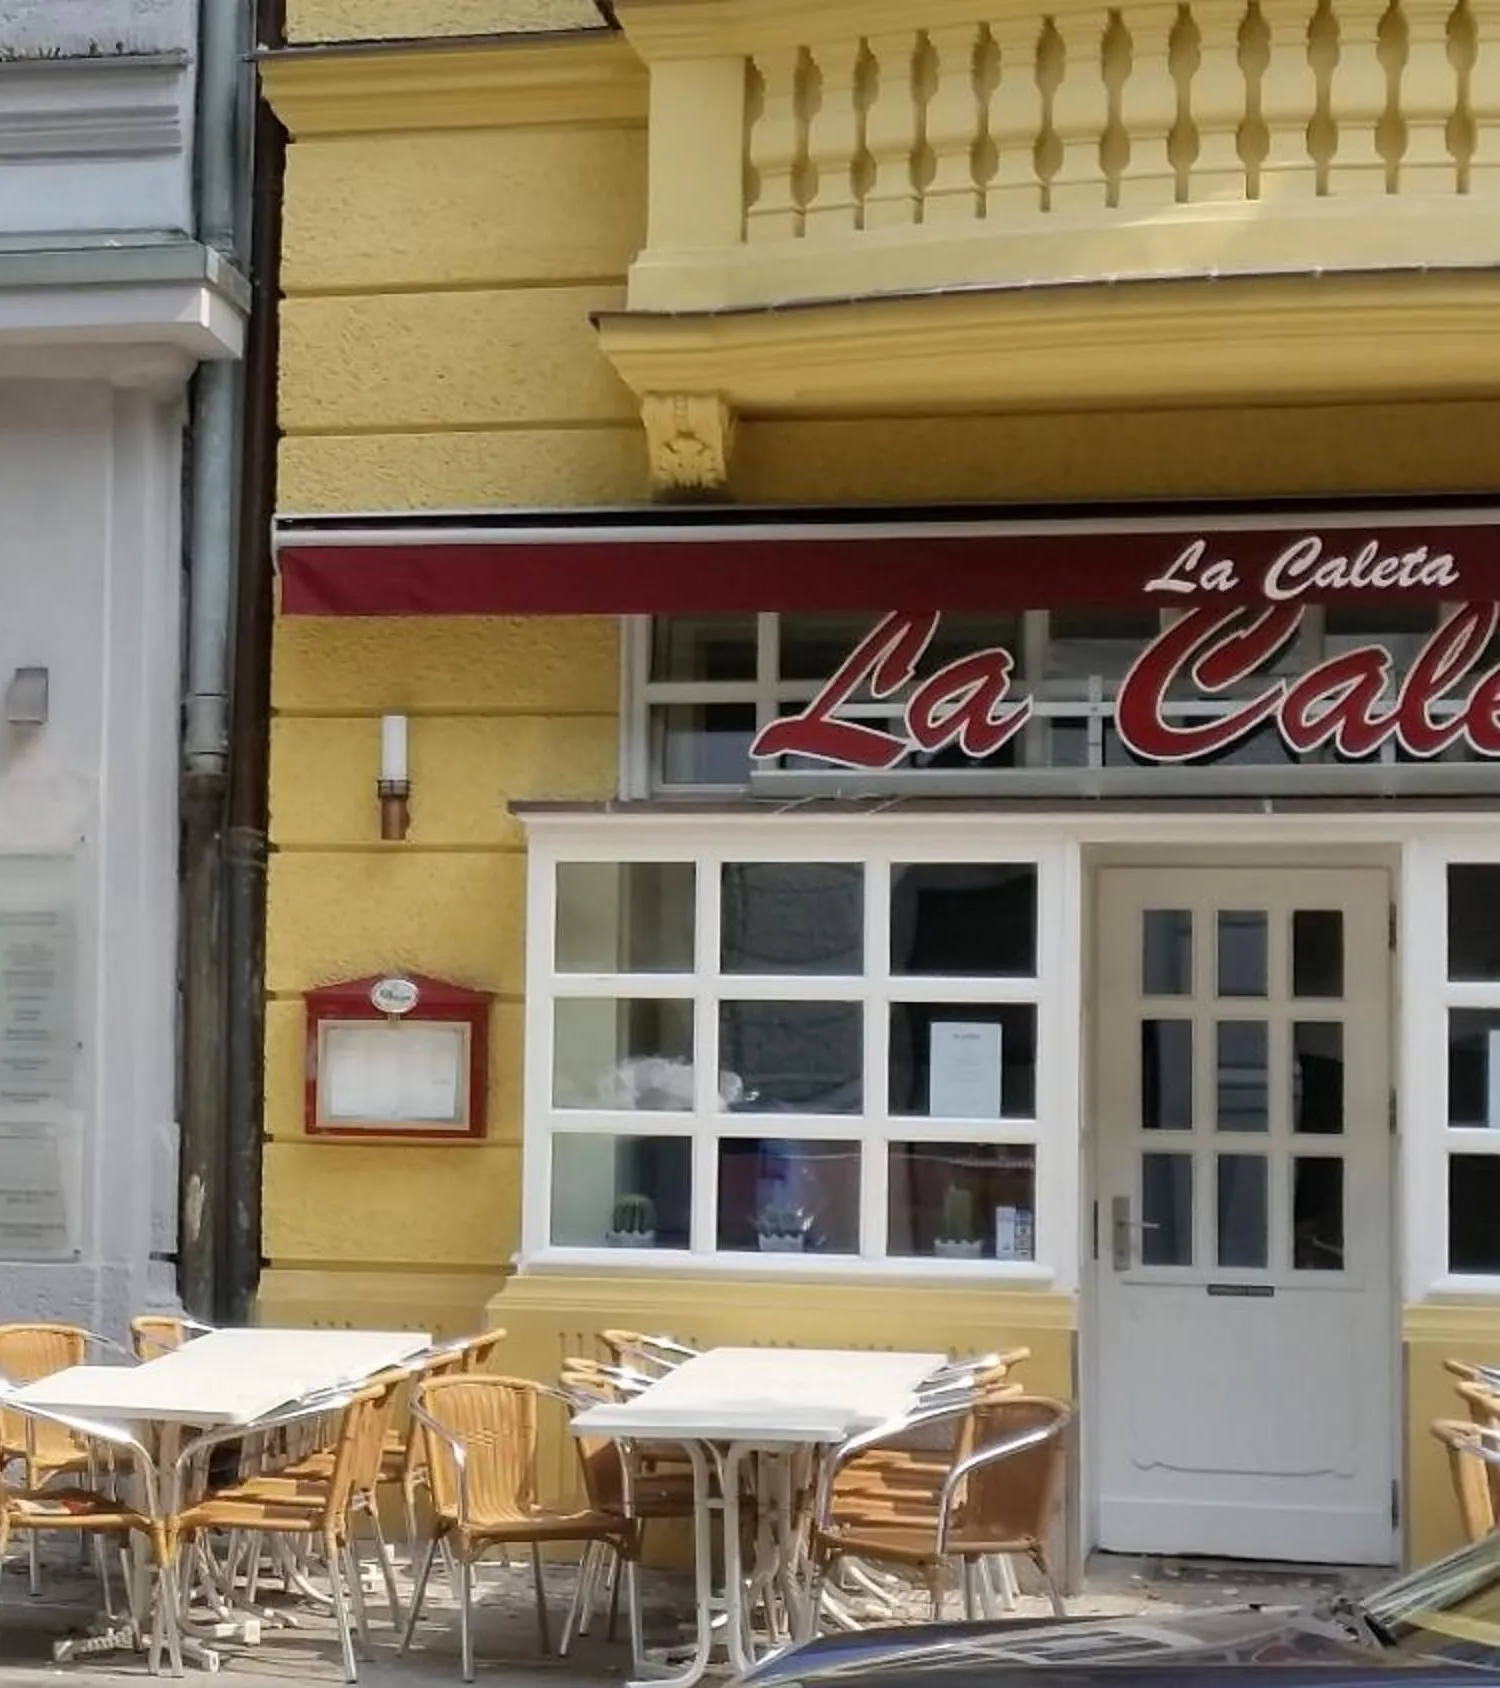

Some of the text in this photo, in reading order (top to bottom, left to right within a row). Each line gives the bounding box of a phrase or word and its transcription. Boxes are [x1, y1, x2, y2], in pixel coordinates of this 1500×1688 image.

[1143, 535, 1460, 601] La Caleta
[749, 610, 1034, 770] La
